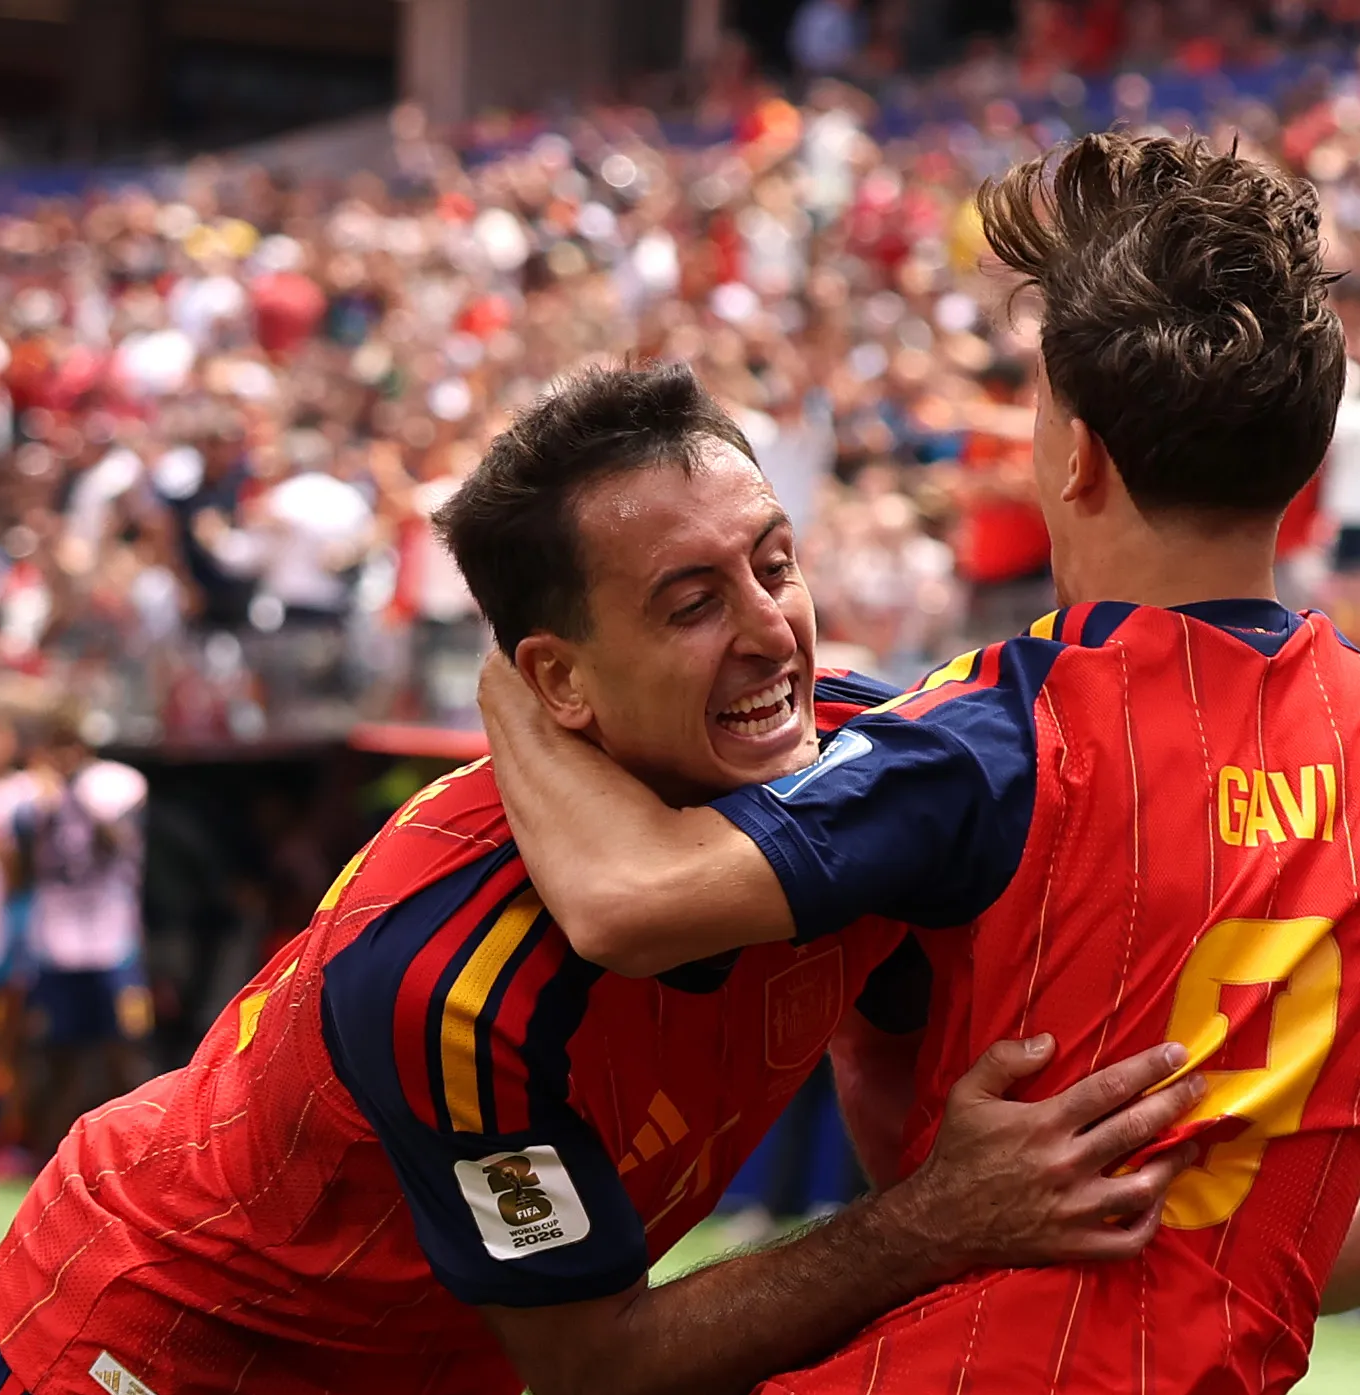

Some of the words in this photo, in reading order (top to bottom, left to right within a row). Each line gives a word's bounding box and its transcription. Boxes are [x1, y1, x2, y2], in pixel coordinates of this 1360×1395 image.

[1218, 763, 1337, 847] GAVI
[1104, 916, 1342, 1229] 9
[515, 1205, 541, 1220] FIFA
[508, 1225, 541, 1237] WORLD
[541, 1219, 559, 1230] CUP
[512, 1227, 564, 1249] 2026
